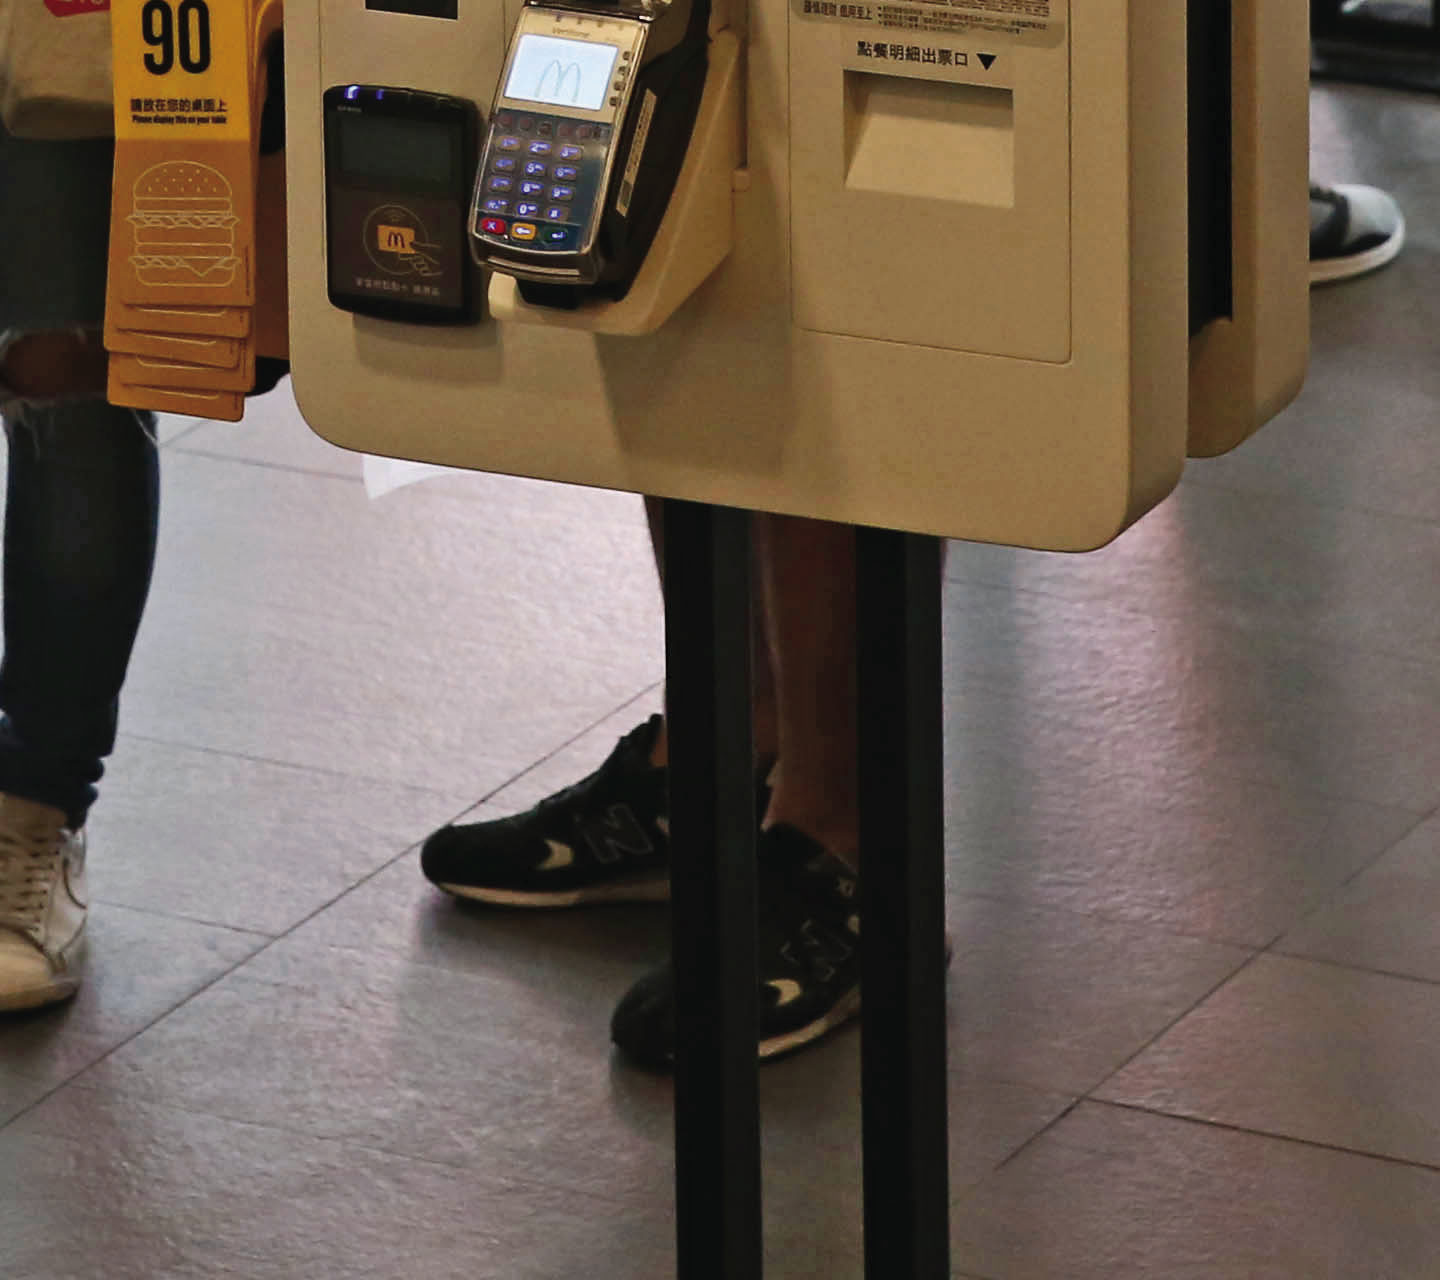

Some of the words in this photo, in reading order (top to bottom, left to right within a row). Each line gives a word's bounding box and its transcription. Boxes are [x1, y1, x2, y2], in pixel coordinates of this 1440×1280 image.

[857, 40, 969, 67] 點餐明細出票口
